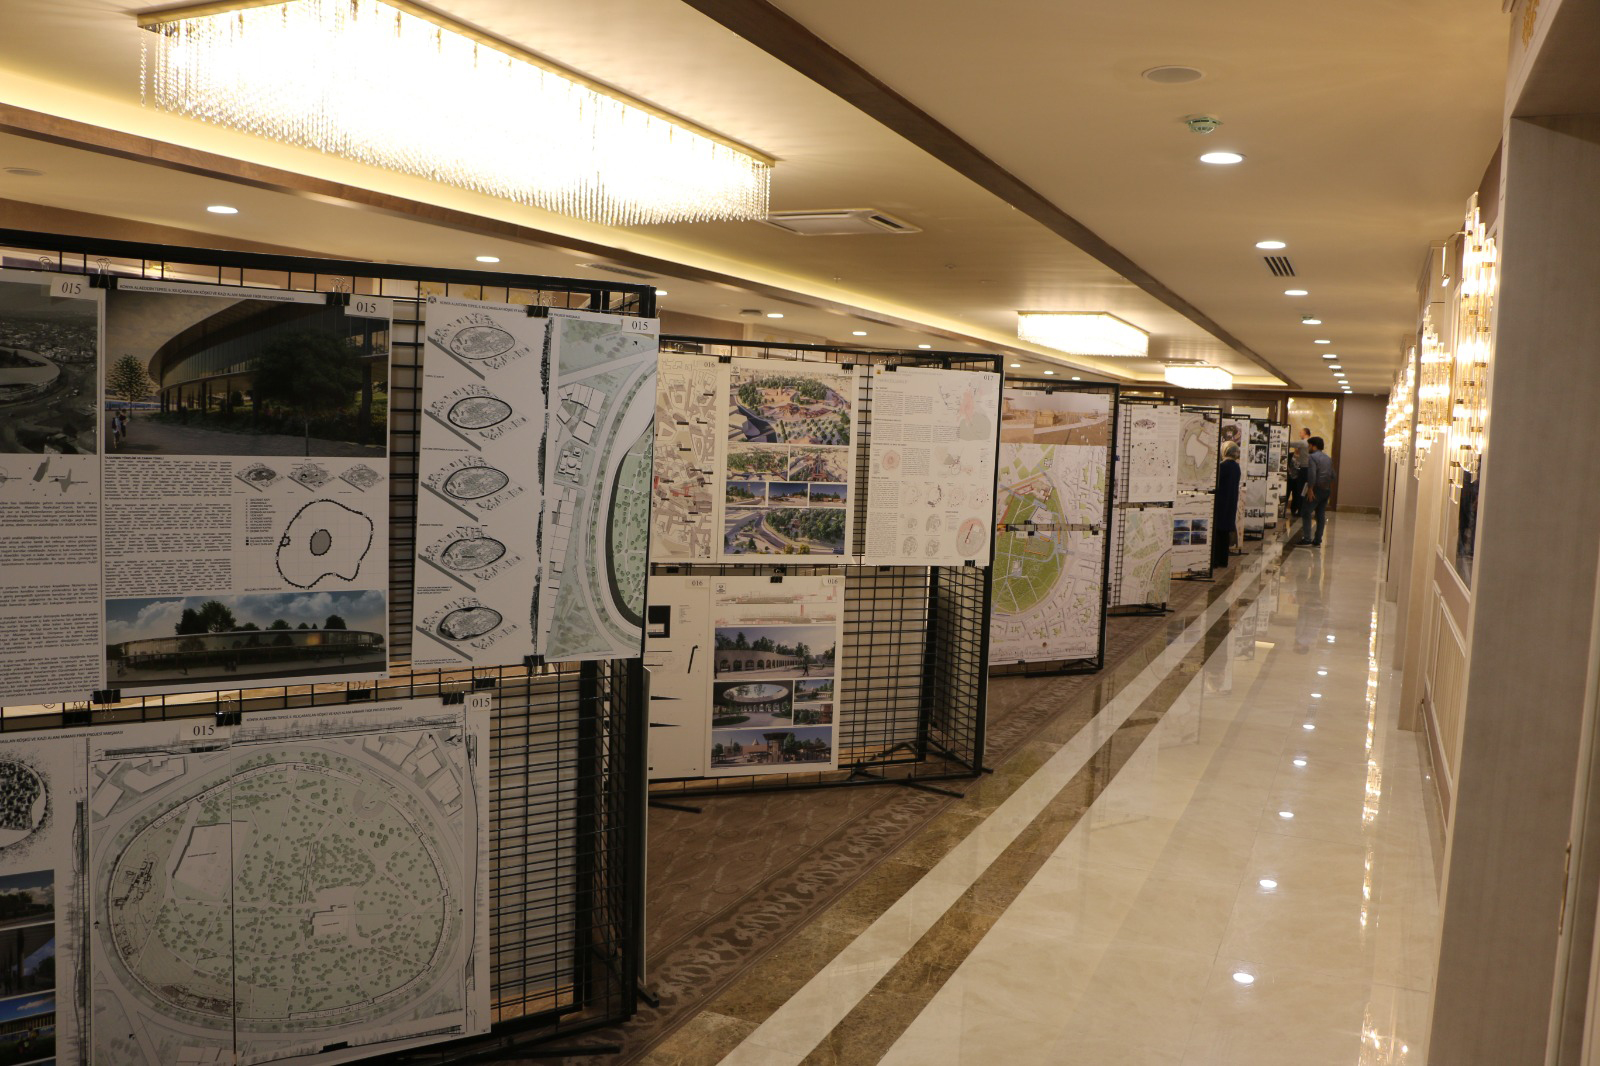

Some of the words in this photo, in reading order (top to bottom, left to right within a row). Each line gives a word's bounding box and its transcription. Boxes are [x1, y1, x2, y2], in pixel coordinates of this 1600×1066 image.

[61, 281, 82, 295] 015
[356, 301, 377, 314] 015
[631, 320, 649, 331] 015
[691, 579, 704, 587] 016
[472, 697, 490, 708] 015
[193, 724, 215, 737] 015
